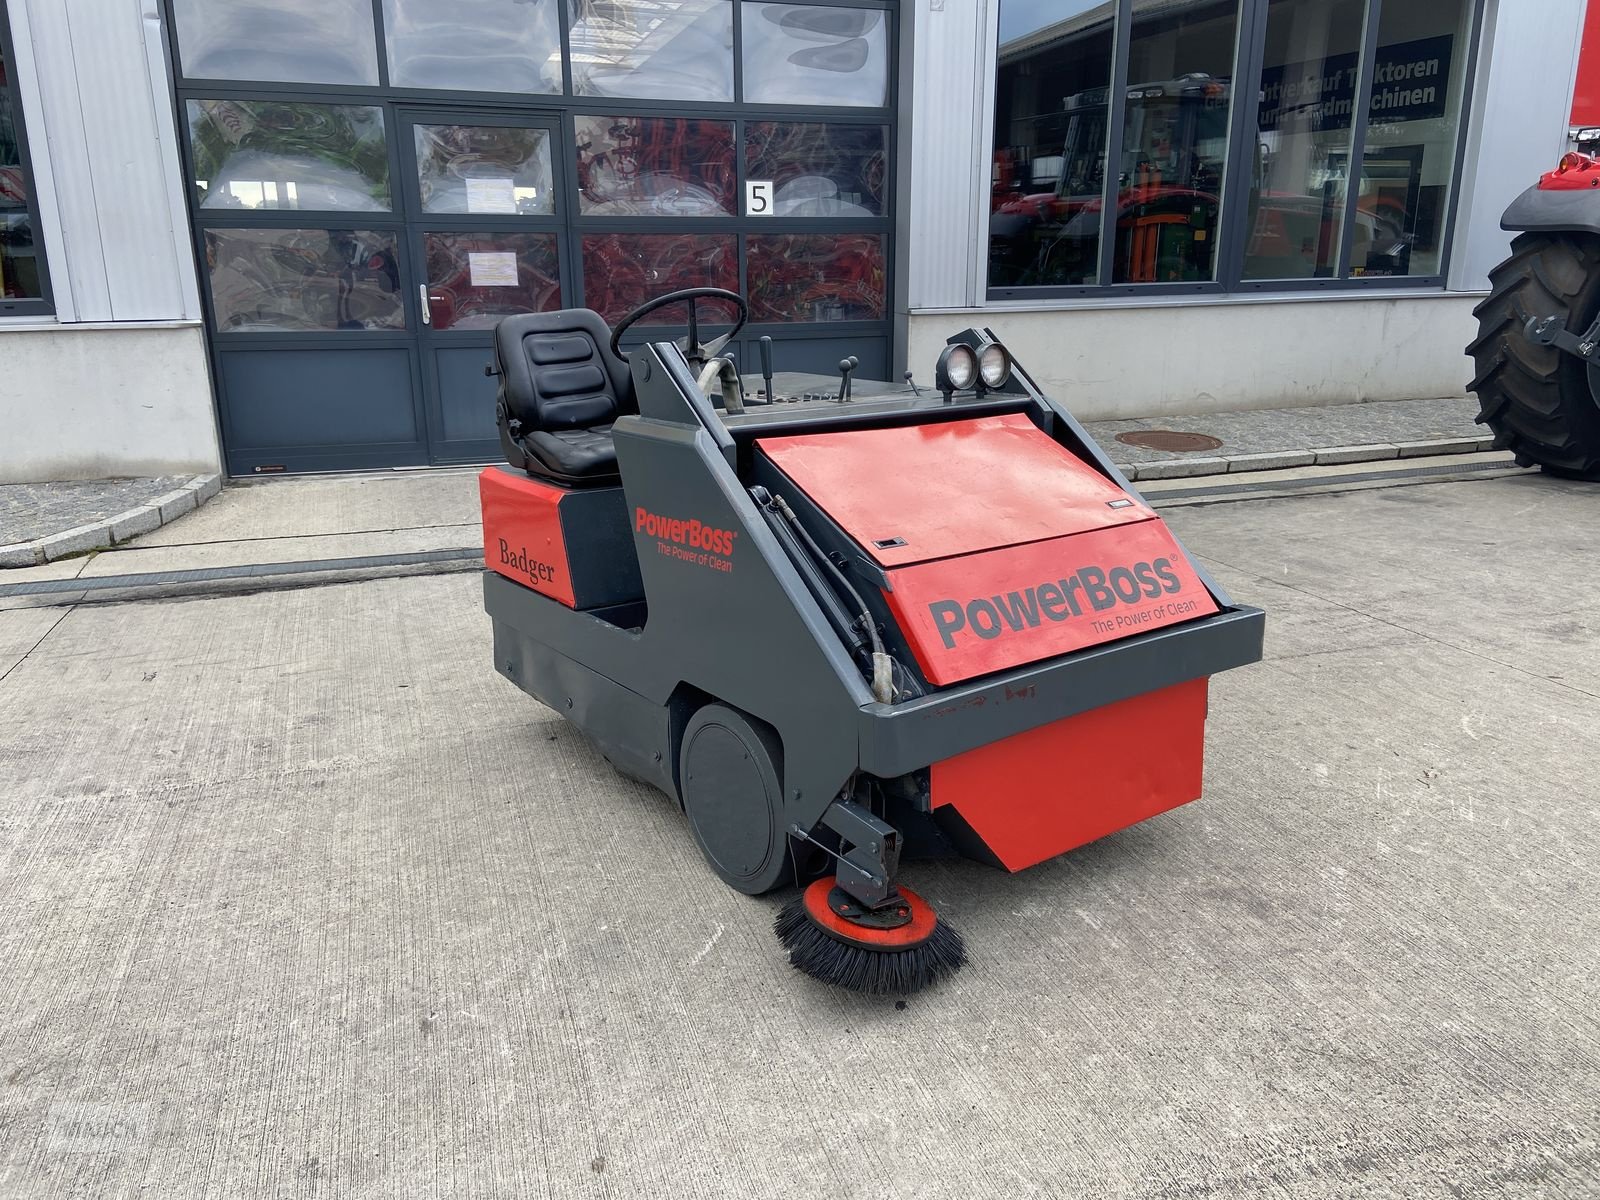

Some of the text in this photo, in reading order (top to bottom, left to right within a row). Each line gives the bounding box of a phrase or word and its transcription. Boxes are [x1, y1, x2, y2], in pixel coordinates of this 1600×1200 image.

[752, 185, 767, 213] 5
[498, 537, 555, 585] Badger
[656, 541, 733, 573] The Power of Clean
[1091, 599, 1198, 634] The Power of Clean
